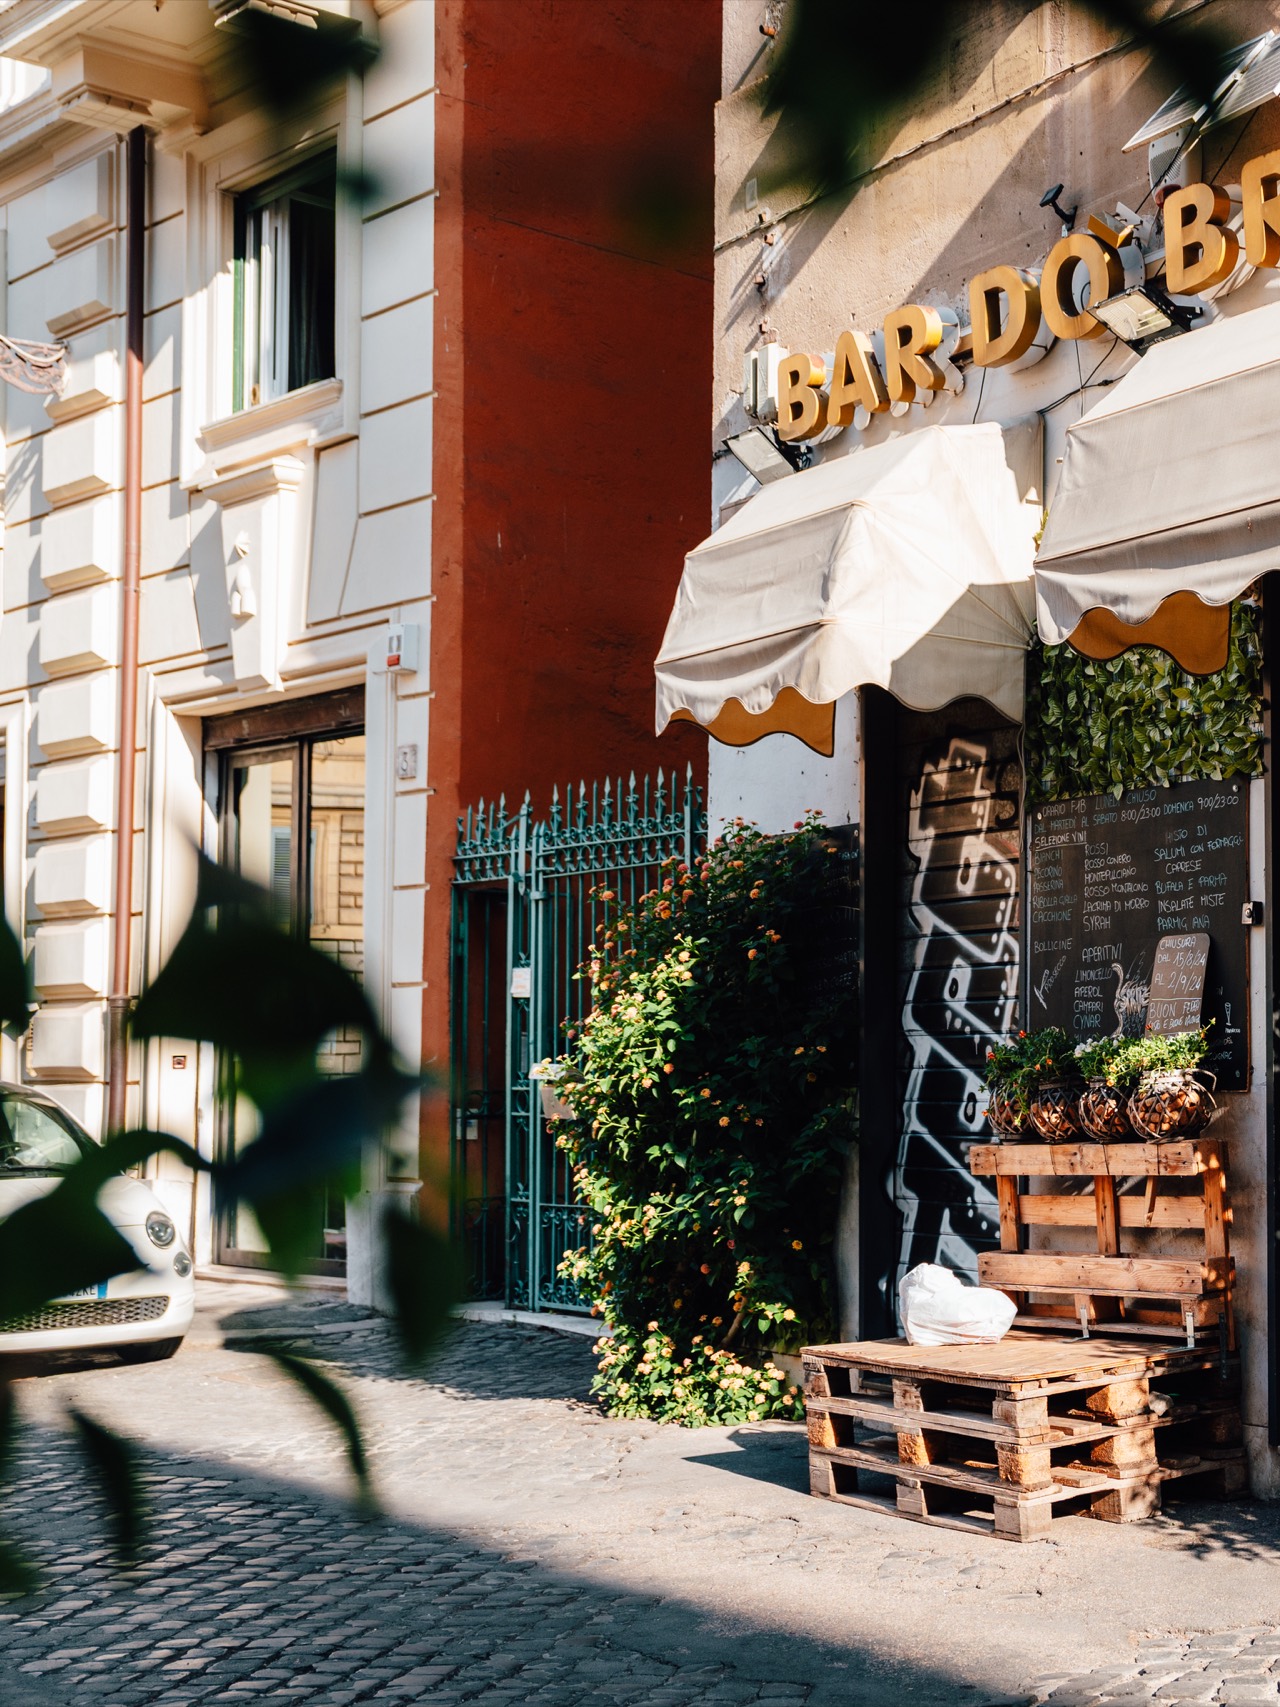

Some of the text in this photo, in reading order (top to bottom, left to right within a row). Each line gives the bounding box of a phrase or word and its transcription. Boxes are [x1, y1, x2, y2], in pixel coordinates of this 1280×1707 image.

[777, 304, 947, 442] BAR
[1042, 804, 1066, 817] ORARIO
[1126, 789, 1157, 804] CHIUSO
[1034, 825, 1047, 834] DAL
[1082, 816, 1089, 827] AL
[1093, 812, 1118, 826] SABATO
[1164, 801, 1194, 814] DOMENICA
[1197, 824, 1208, 836] DI
[1035, 831, 1087, 849] SELEZIONE VINI
[1034, 850, 1064, 864] BIANCHI
[1084, 843, 1109, 856] ROSSI
[1154, 846, 1186, 862] SALUMI
[1190, 843, 1204, 854] CON
[1084, 854, 1132, 871] ROSSO CONERO
[1166, 860, 1202, 875] CAPRESE
[1084, 866, 1137, 885] MONTEPULCIANO
[1154, 872, 1228, 894] BUFALA E PARMA
[1084, 886, 1110, 898] ROSSO
[1032, 896, 1058, 910] RIBOLLA
[1082, 898, 1150, 914] LACRIMA DI MORRO
[1158, 893, 1226, 914] INSALATE MISTE
[1032, 908, 1072, 924] CACCHIONE
[1083, 916, 1112, 932] SYRAH
[1034, 938, 1073, 954] BOLLICINE
[1160, 936, 1197, 950] CHIUSURA
[1157, 950, 1206, 970] DAL 15/8/24
[1044, 955, 1067, 994] PROSECCO
[1074, 967, 1114, 983] LIMONCELLO
[1154, 973, 1165, 985] AL
[1168, 972, 1202, 994] 2/9/24
[1074, 986, 1103, 998] APEROL
[1074, 1000, 1104, 1014] CAMPARI
[1149, 1002, 1177, 1018] BUON
[1073, 1014, 1101, 1030] CYNAR
